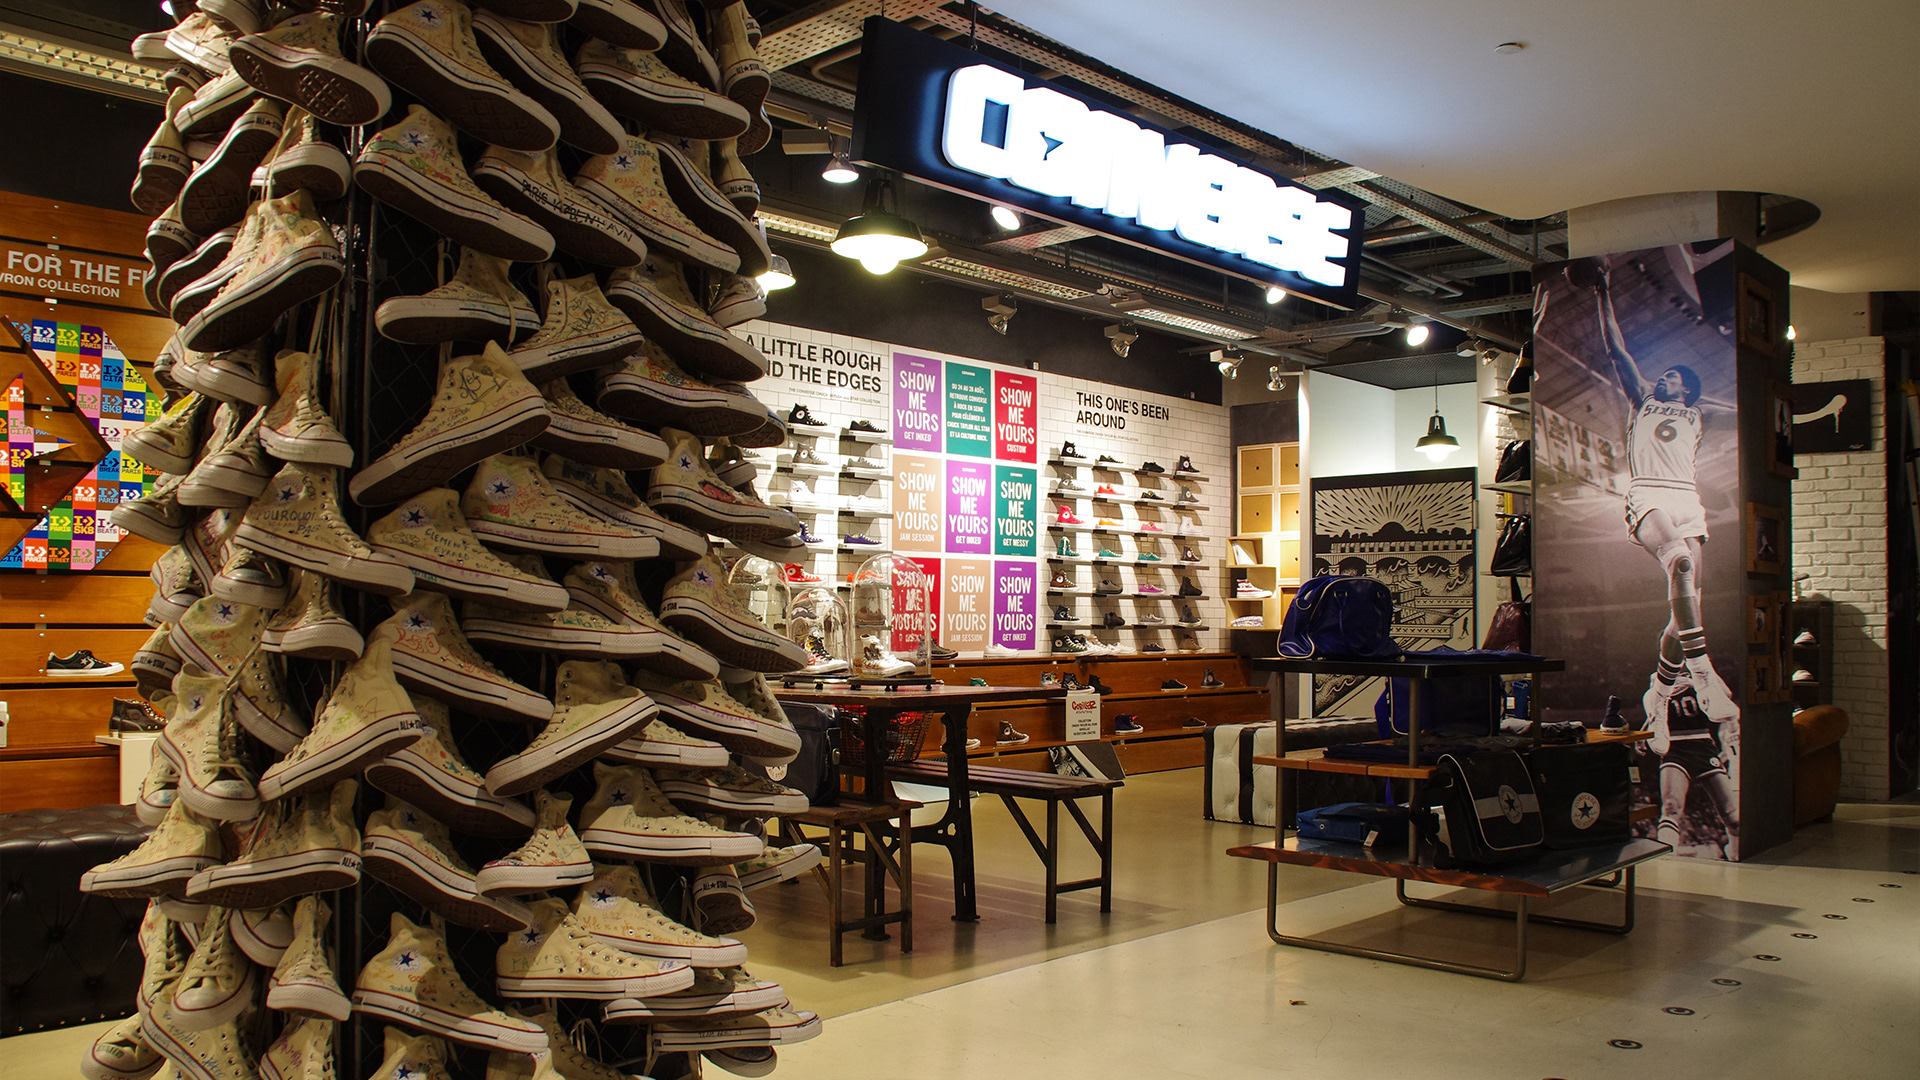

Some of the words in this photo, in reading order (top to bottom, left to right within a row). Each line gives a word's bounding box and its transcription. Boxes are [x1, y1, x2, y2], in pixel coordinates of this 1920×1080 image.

[736, 65, 744, 74] ALL
[7, 250, 62, 277] FOR
[70, 259, 121, 285] THE
[38, 278, 120, 298] COLLECTION
[33, 335, 55, 344] BEATS
[57, 338, 78, 347] CITA
[761, 336, 817, 362] LITTLE
[822, 348, 881, 372] ROUGH
[103, 374, 123, 383] CITA
[788, 363, 822, 384] THE
[827, 369, 882, 393] EDGES
[900, 370, 936, 392] SHOW
[908, 391, 926, 410] ME
[1000, 387, 1032, 408] SHOW
[1076, 392, 1102, 408] THIS
[1106, 396, 1139, 416] ONE'S
[1141, 404, 1170, 421] BEEN
[102, 405, 122, 414] SK8
[1008, 406, 1024, 425] ME
[1642, 404, 1697, 426] SIXERS
[896, 409, 939, 432] YOURS
[1076, 410, 1126, 430] AROUND
[904, 431, 914, 440] GET
[915, 432, 932, 442] INKED
[998, 422, 1035, 444] YOURS
[1655, 419, 1677, 442] 6
[1007, 444, 1026, 454] CUSTOM
[11, 459, 24, 467] SK
[899, 471, 936, 492] SHOW
[952, 476, 986, 496] SHOW
[1000, 480, 1032, 500] SHOW
[652, 491, 662, 500] STAR
[908, 492, 926, 510] ME
[960, 496, 978, 515] ME
[1008, 500, 1024, 518] ME
[74, 526, 94, 534] SK8
[895, 511, 938, 532] YOURS
[948, 514, 989, 535] YOURS
[997, 518, 1034, 537] YOURS
[425, 528, 468, 550] CLEMENT
[912, 533, 935, 542] SESSION
[956, 535, 966, 544] GET
[1003, 538, 1012, 546] GET
[1013, 539, 1029, 547] MESSY
[951, 575, 985, 593] SHOW
[1000, 576, 1032, 594] SHOW
[667, 602, 678, 611] STAR
[959, 595, 976, 612] ME
[1008, 595, 1023, 612] ME
[947, 614, 986, 631] YOURS
[996, 613, 1033, 631] YOURS
[400, 721, 409, 730] ALL
[342, 857, 352, 867] ALL
[716, 880, 727, 889] STAR
